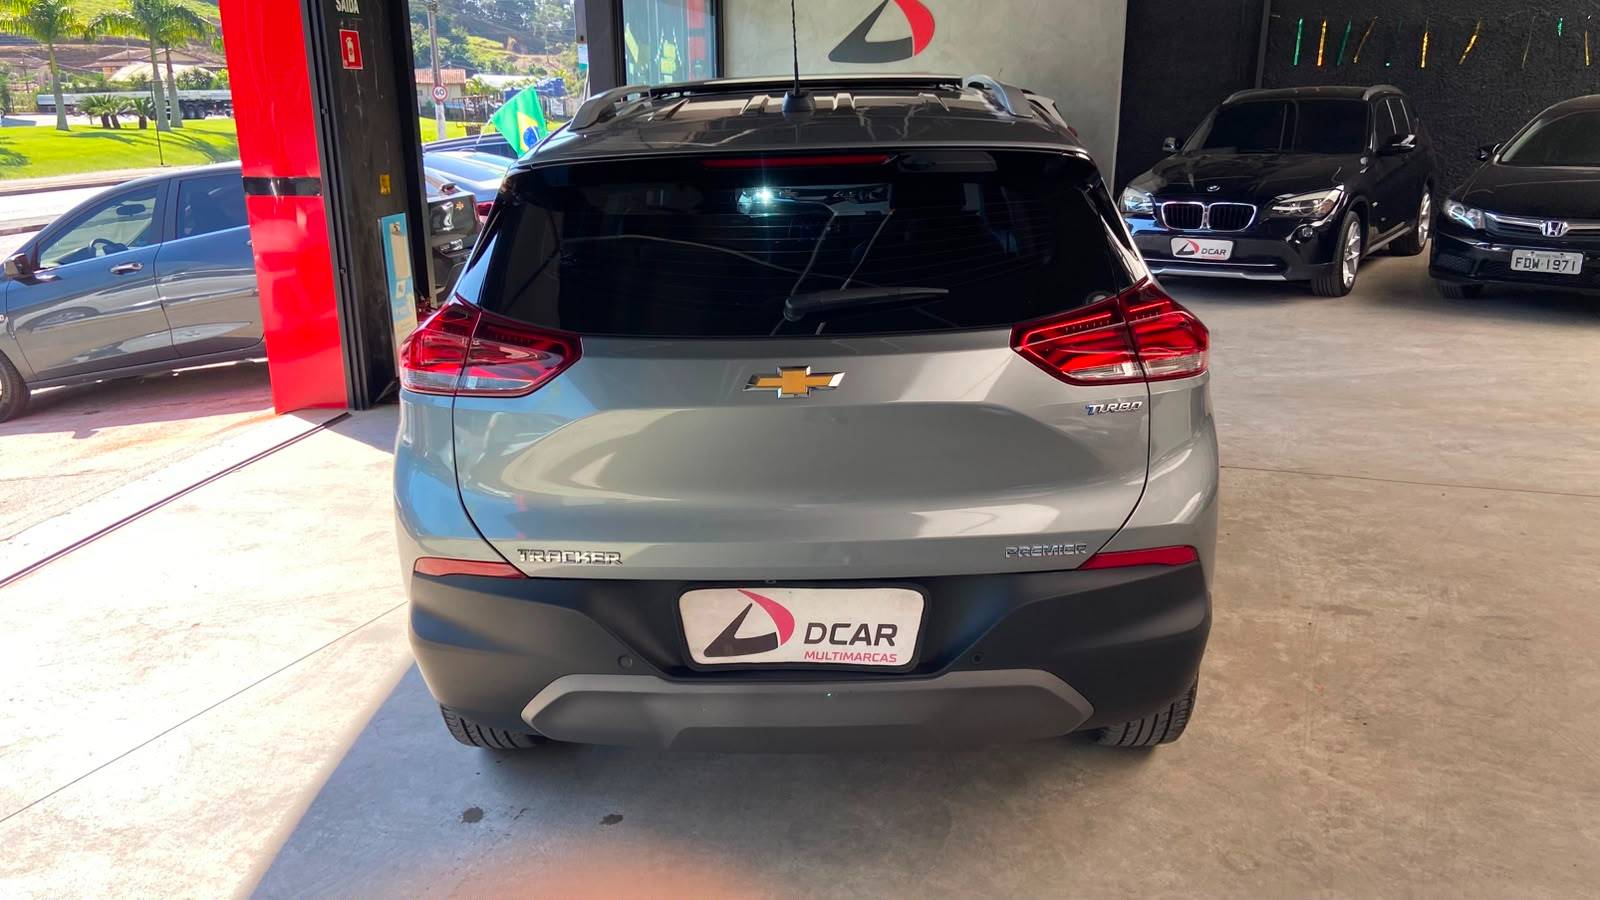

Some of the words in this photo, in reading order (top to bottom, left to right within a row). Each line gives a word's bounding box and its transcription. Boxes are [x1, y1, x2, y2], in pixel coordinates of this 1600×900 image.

[1200, 248, 1227, 256] DCAR
[1085, 401, 1143, 415] TURBO
[517, 548, 623, 565] TRACKER
[1005, 543, 1087, 558] PREMIER
[803, 622, 898, 647] DCAR
[803, 651, 897, 663] MULTIMARCAS
